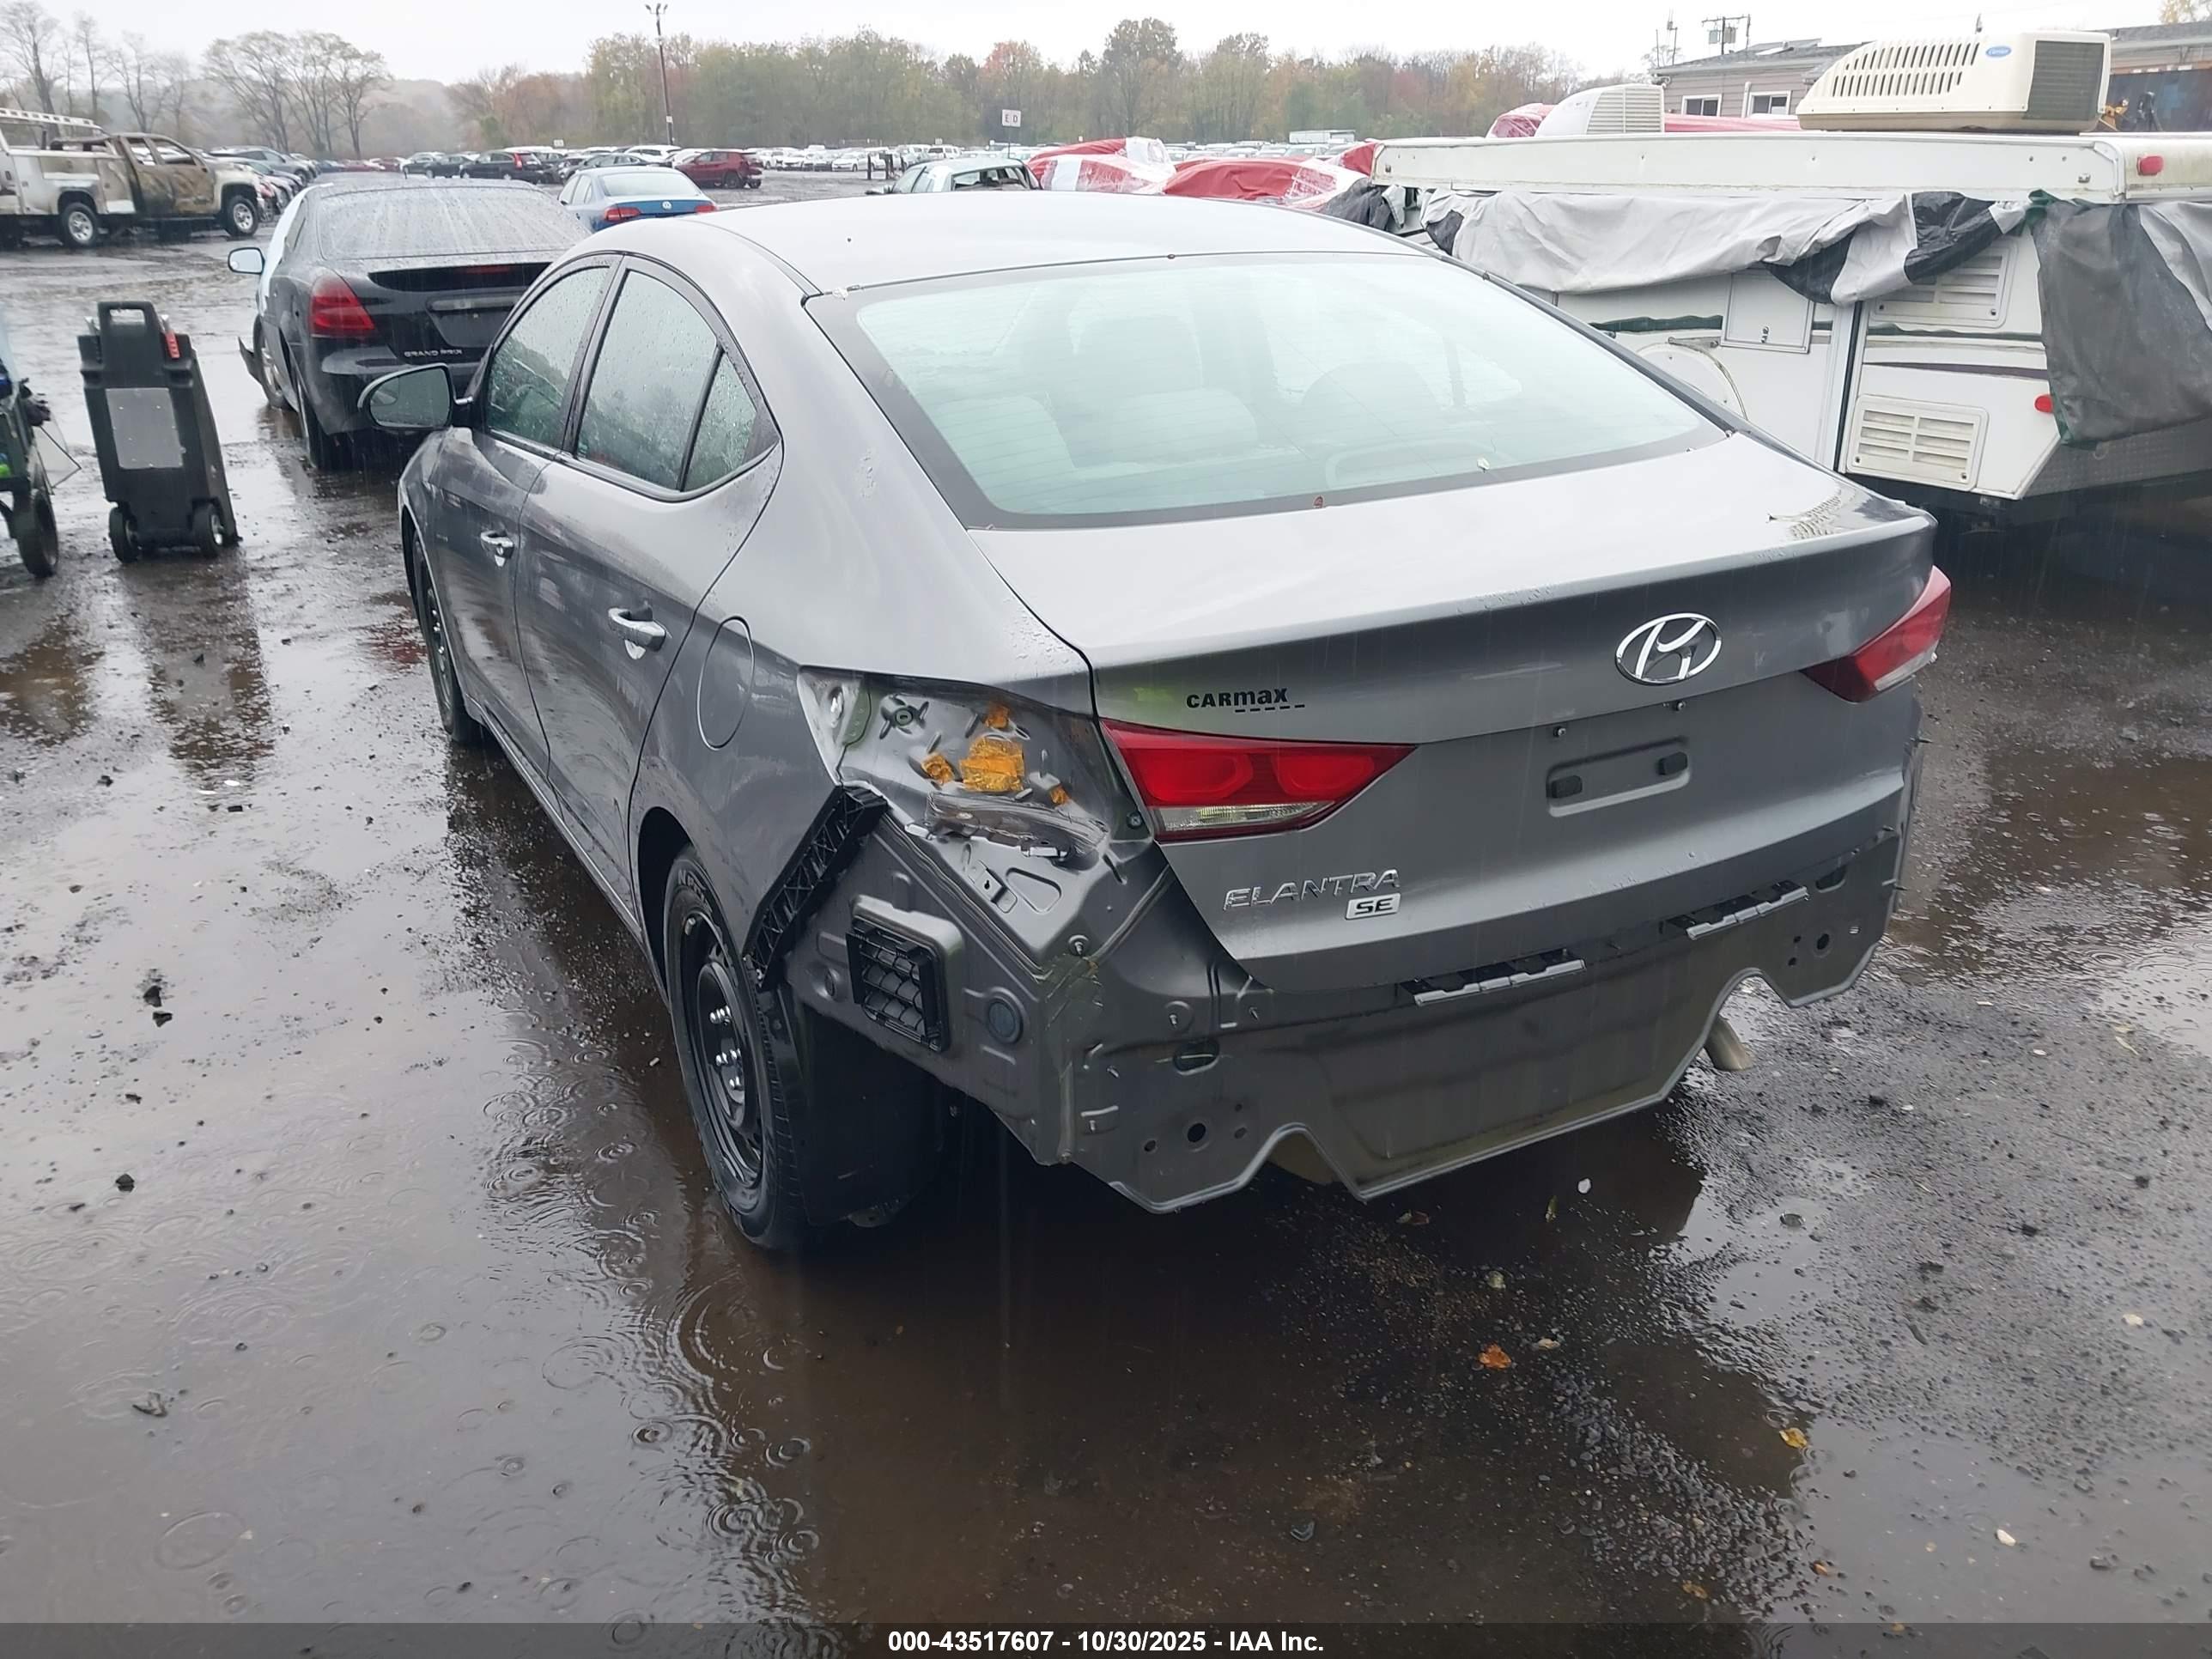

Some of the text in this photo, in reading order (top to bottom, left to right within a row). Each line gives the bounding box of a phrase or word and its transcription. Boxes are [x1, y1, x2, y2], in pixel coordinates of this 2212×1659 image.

[1186, 688, 1288, 708] CARmax
[1223, 869, 1400, 911] ELANTRA
[1353, 896, 1395, 916] SE
